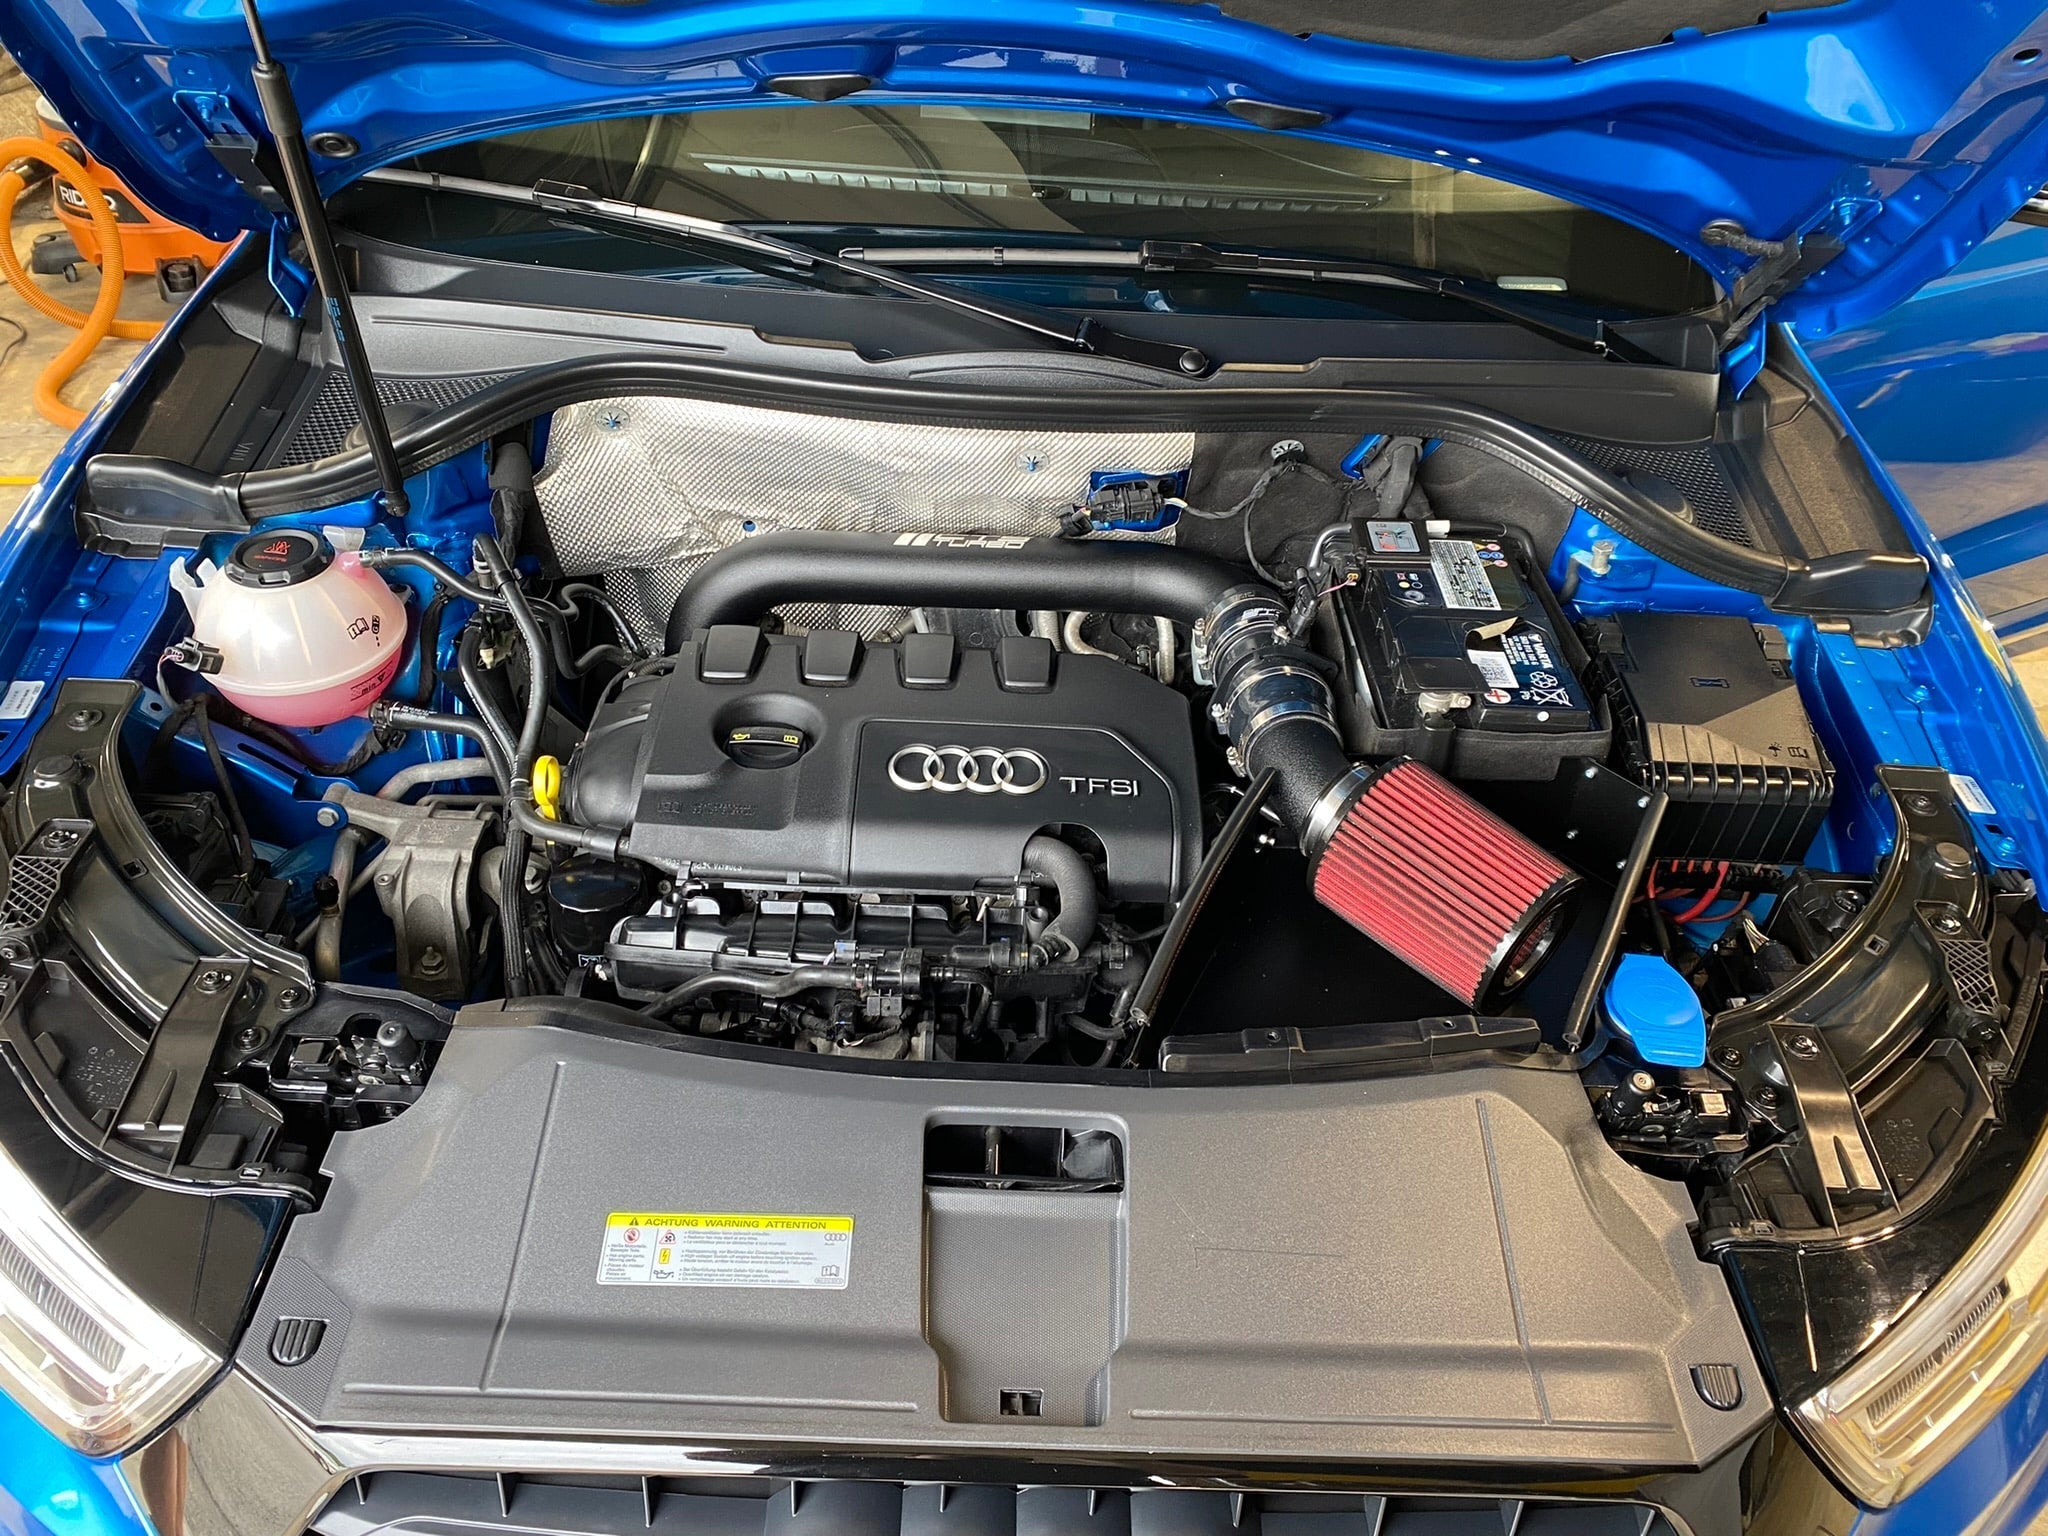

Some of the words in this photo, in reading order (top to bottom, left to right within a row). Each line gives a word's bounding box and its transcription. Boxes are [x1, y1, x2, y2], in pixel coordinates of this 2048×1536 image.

[1533, 643, 1554, 669] VARTA
[1520, 691, 1531, 700] Pb
[1059, 776, 1138, 797] TFSI
[645, 1218, 699, 1227] ACHTUNG
[705, 1219, 760, 1228] WARNING
[765, 1220, 827, 1230] ATTENTION
